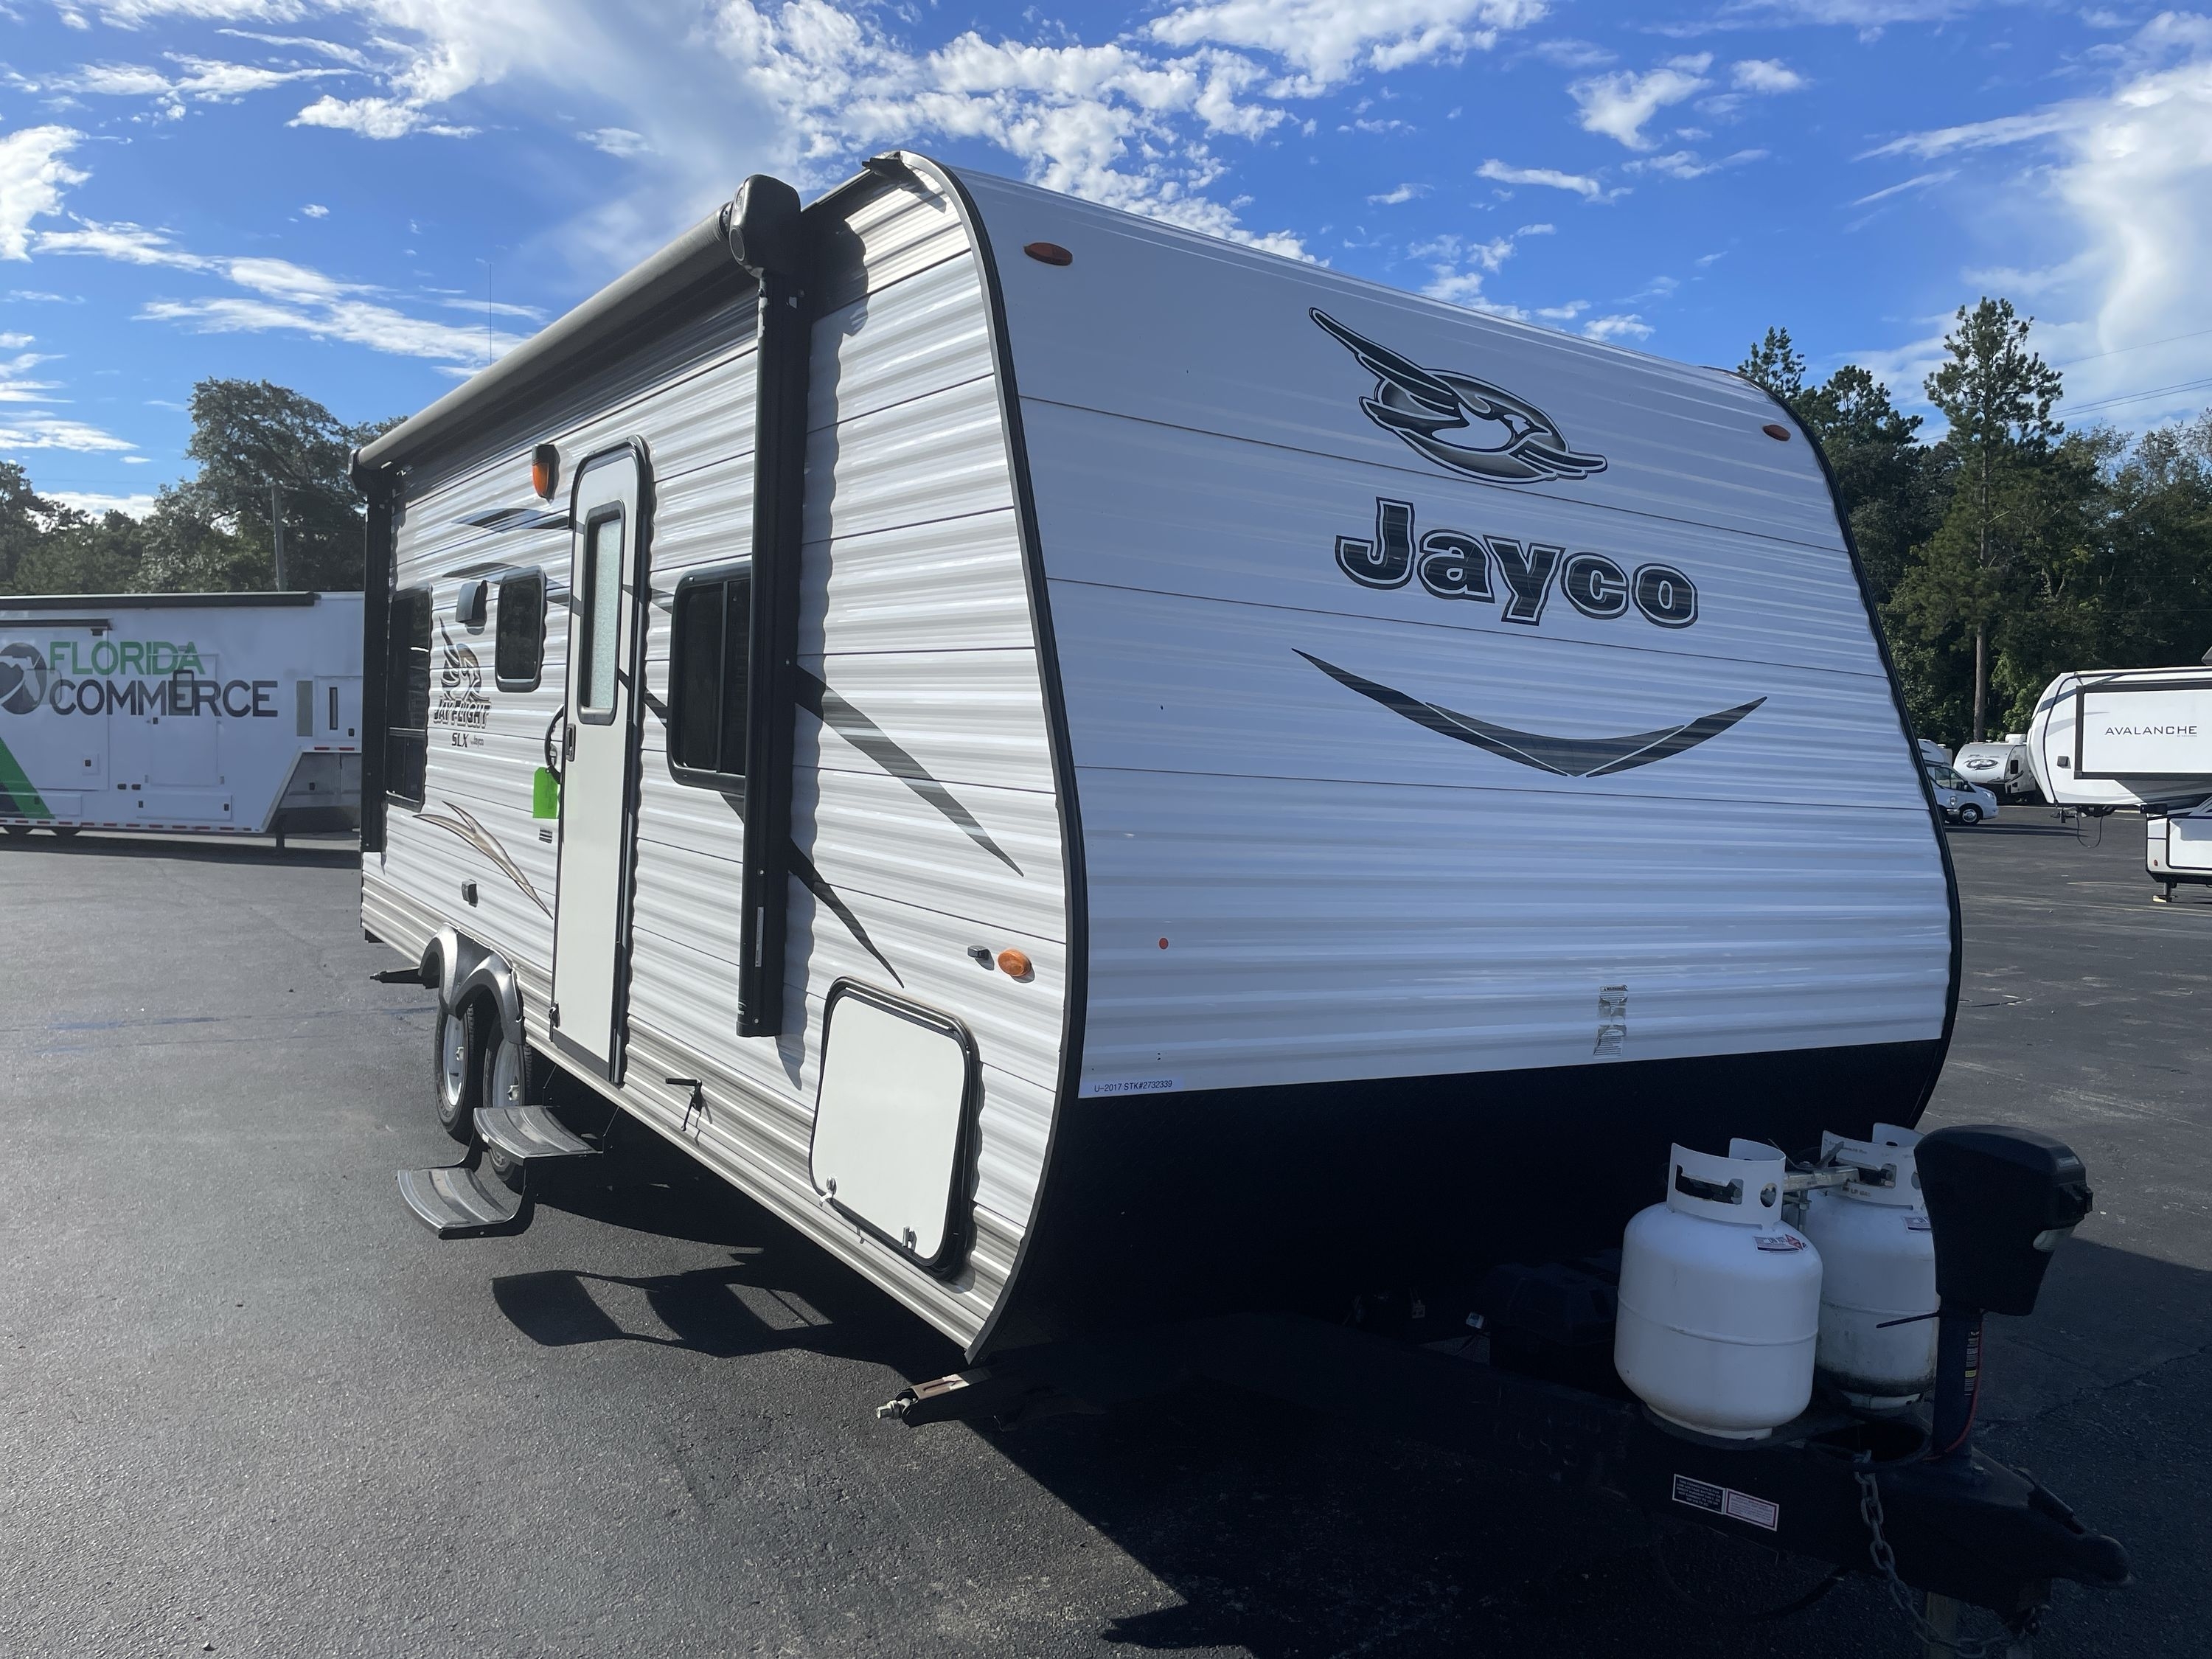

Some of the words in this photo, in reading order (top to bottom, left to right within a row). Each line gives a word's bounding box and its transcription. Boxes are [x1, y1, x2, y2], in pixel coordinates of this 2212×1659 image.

[1335, 496, 1699, 629] Jayco
[49, 641, 206, 675] FLORIDA
[49, 678, 279, 717] COMMERCE
[434, 696, 453, 724] JAY
[451, 697, 492, 729] FLIGHT
[451, 732, 469, 748] SLX
[2104, 726, 2198, 735] AVALANCHE
[1094, 1083, 1122, 1093] U-2017
[1124, 1079, 1173, 1091] STK#2732339
